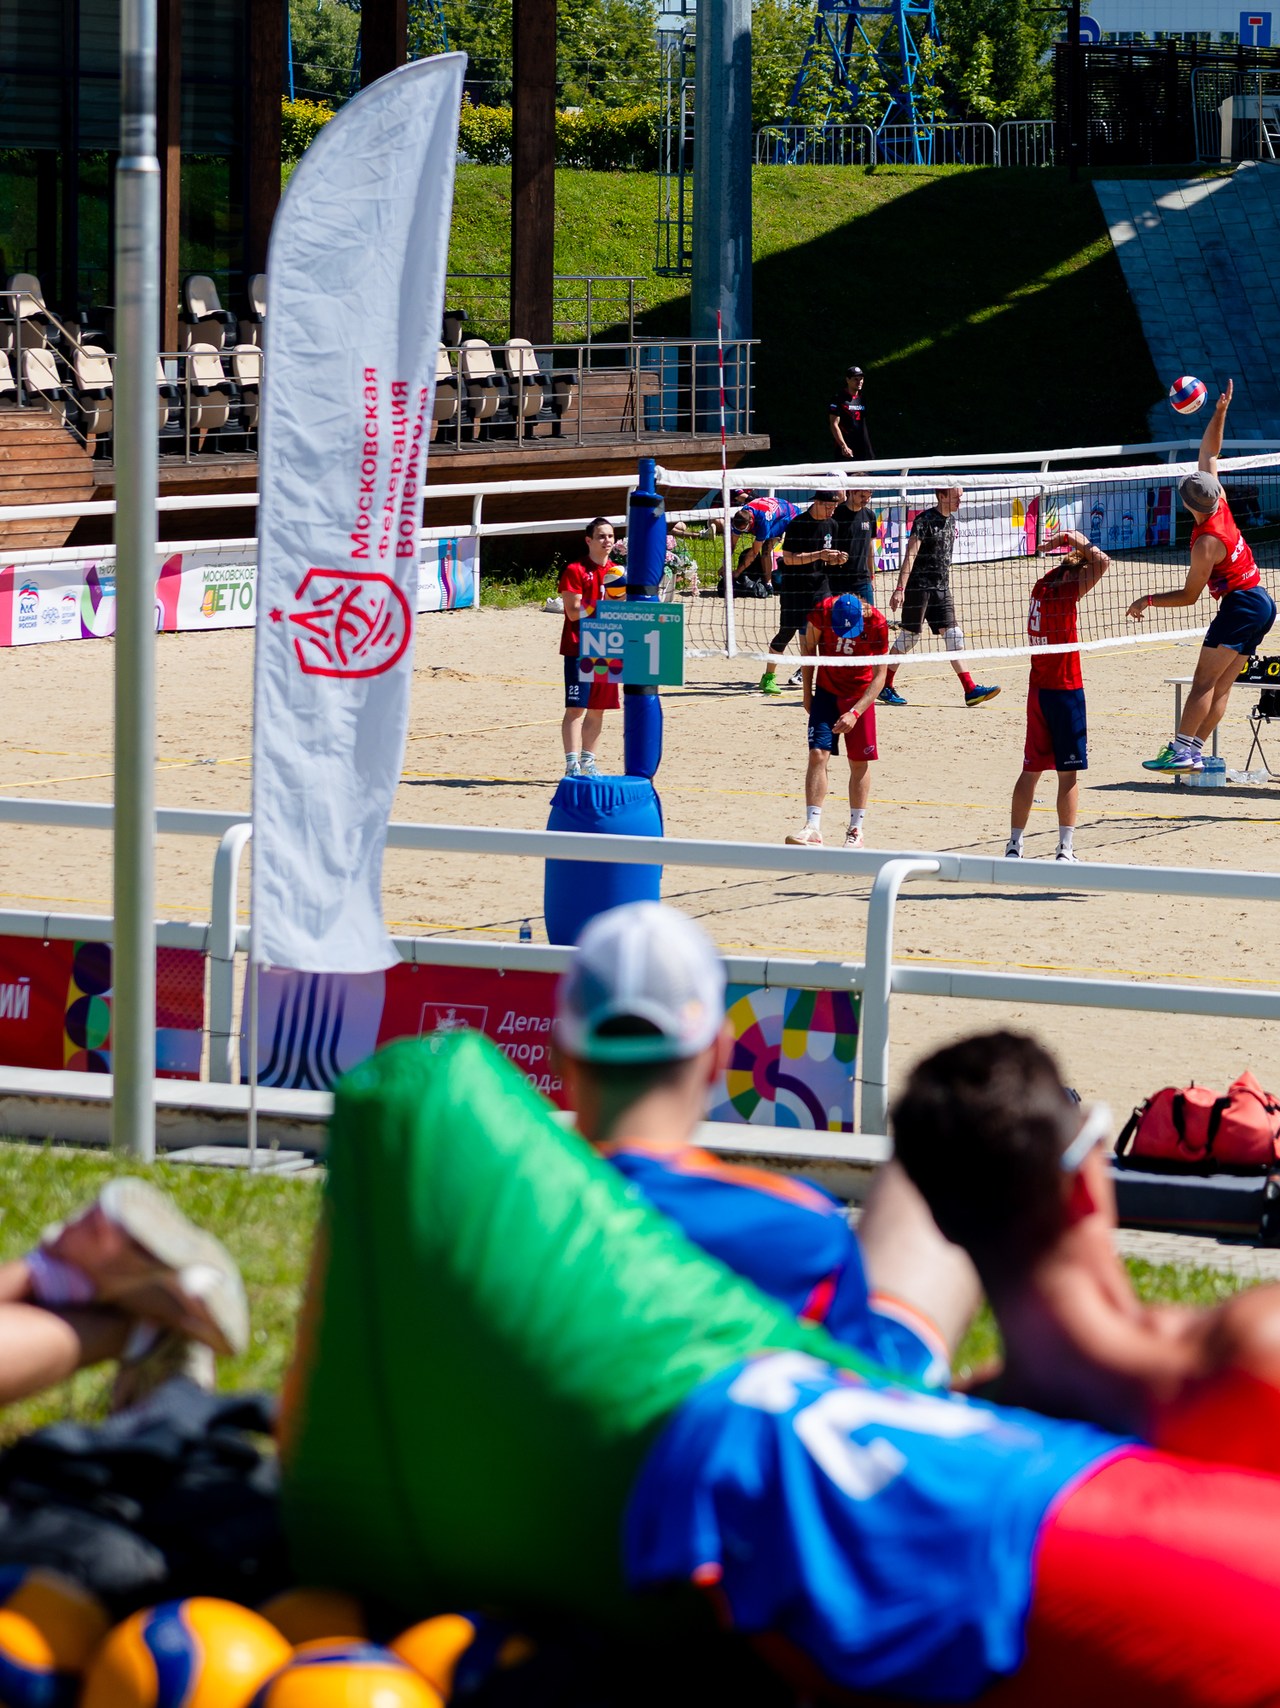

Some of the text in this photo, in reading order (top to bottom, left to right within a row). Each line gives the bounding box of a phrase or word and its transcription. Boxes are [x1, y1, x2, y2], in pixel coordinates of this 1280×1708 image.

[349, 367, 378, 559] Московская
[202, 568, 256, 582] МОСКОВСКОЕ
[200, 581, 253, 612] ЛЕТО
[600, 612, 655, 622] МОСКОВСКОЕ
[582, 622, 623, 630] ПЛОЩАДКА
[643, 630, 660, 675] 1
[1267, 662, 1280, 676] 0
